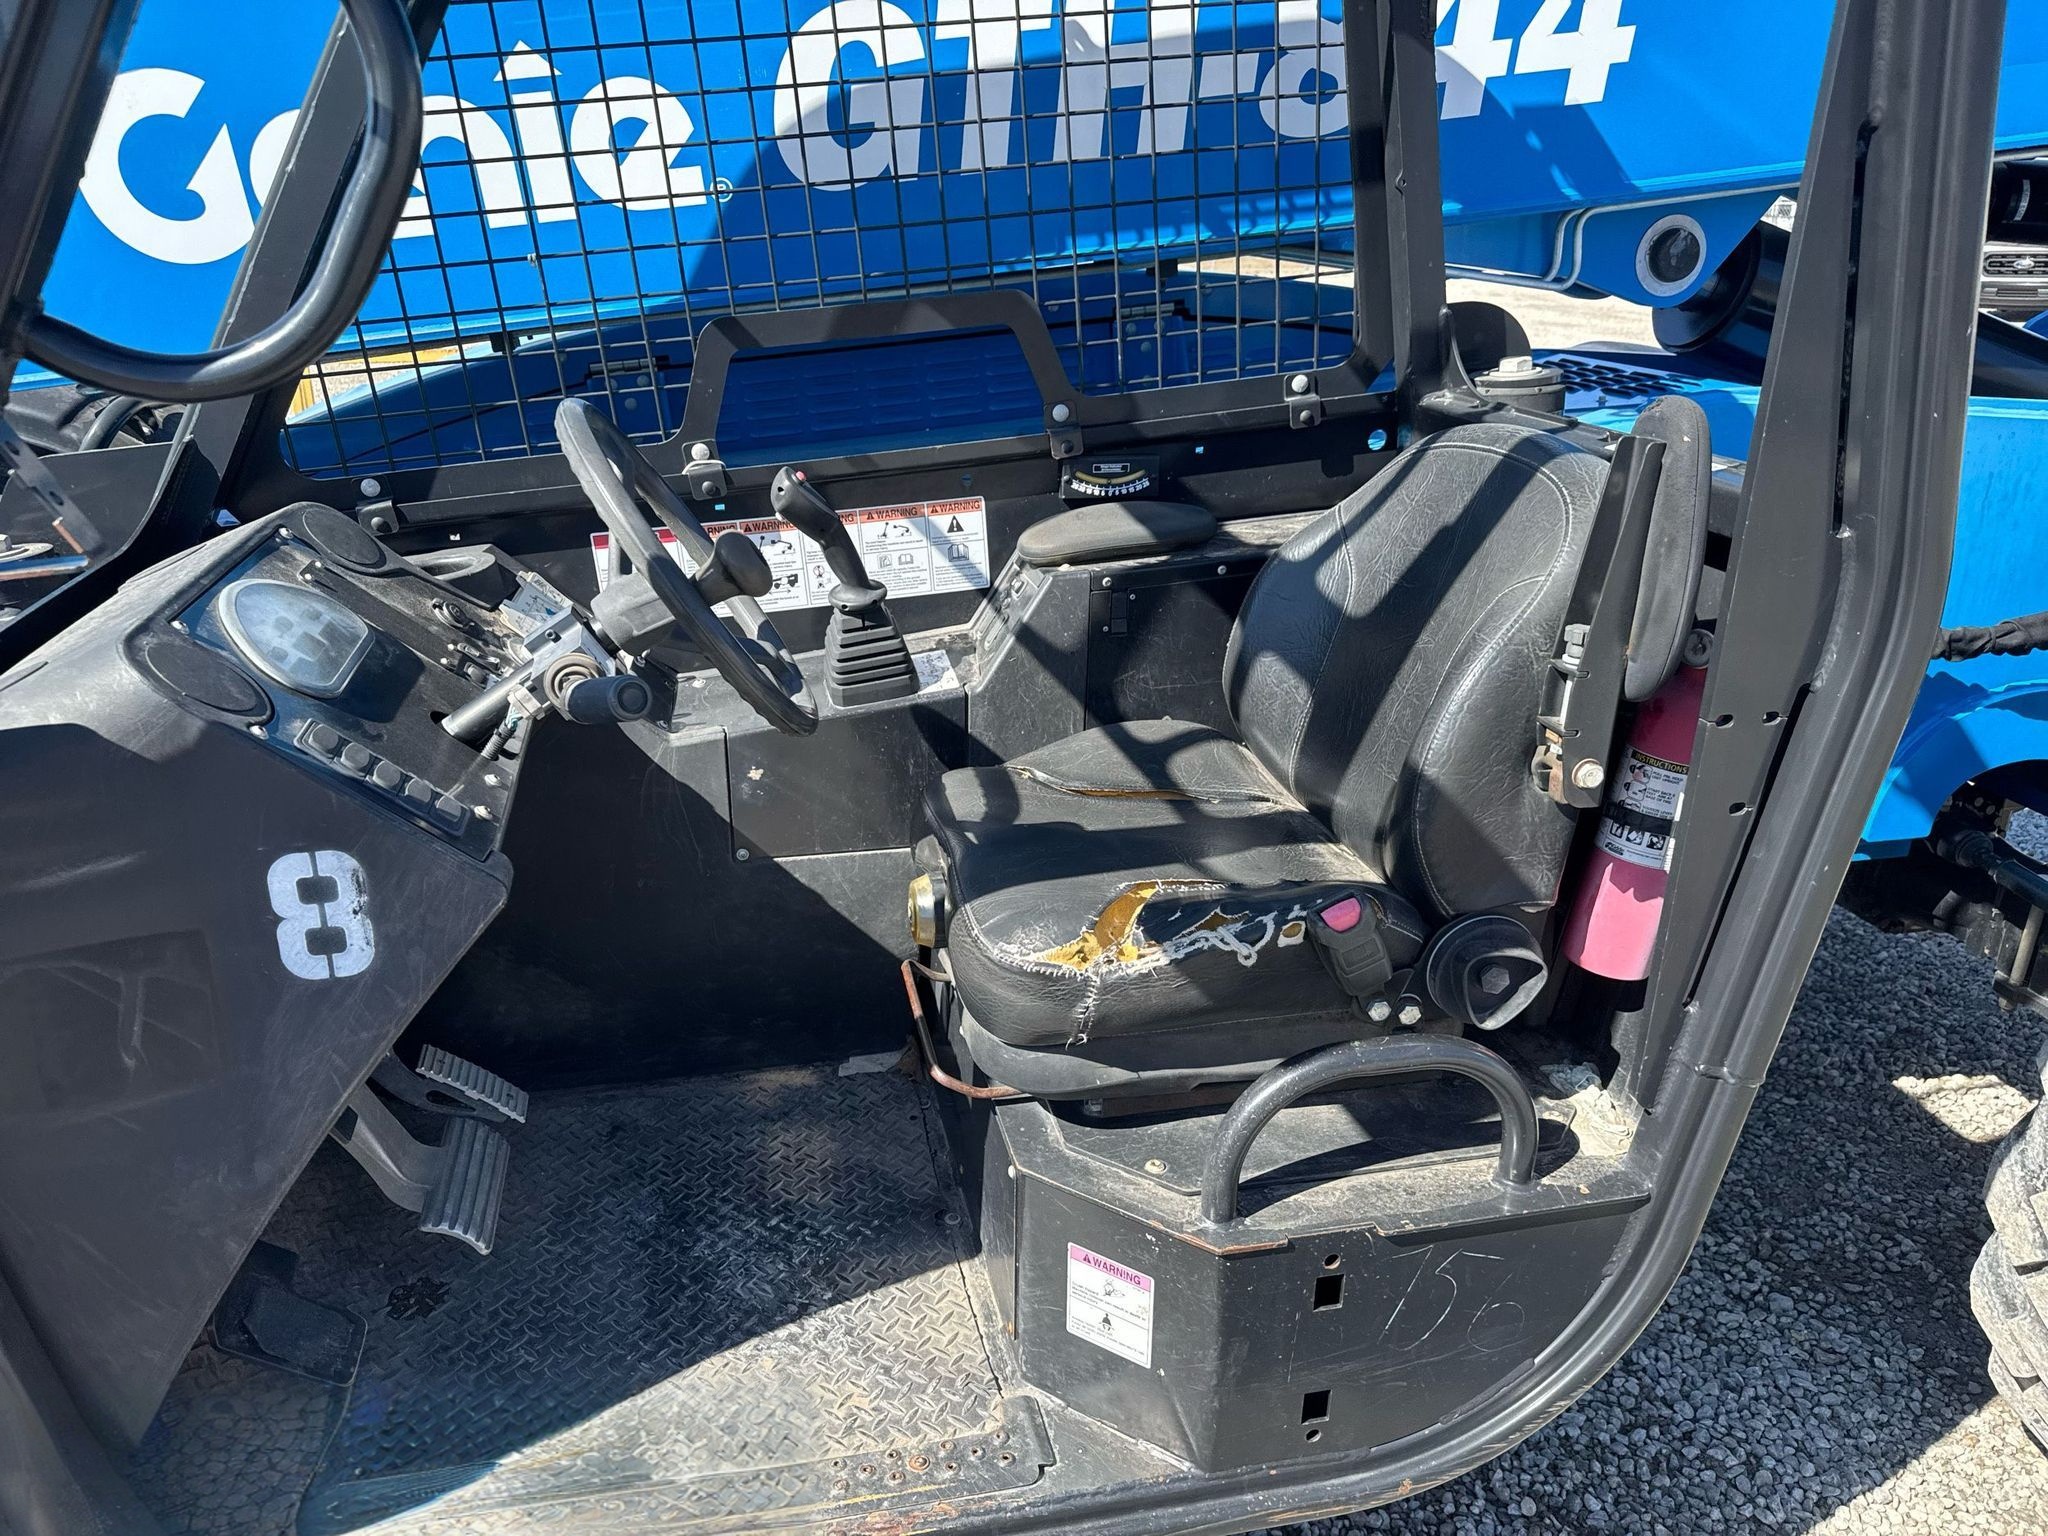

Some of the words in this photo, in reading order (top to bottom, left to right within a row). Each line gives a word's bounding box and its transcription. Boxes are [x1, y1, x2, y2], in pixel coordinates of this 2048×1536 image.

[774, 0, 1637, 191] GTH-844
[875, 507, 918, 520] WARNING
[939, 500, 981, 514] WARNING
[1634, 753, 1688, 774] INSTRUCTIONS
[267, 850, 375, 981] 8
[1093, 1256, 1141, 1286] WARNING
